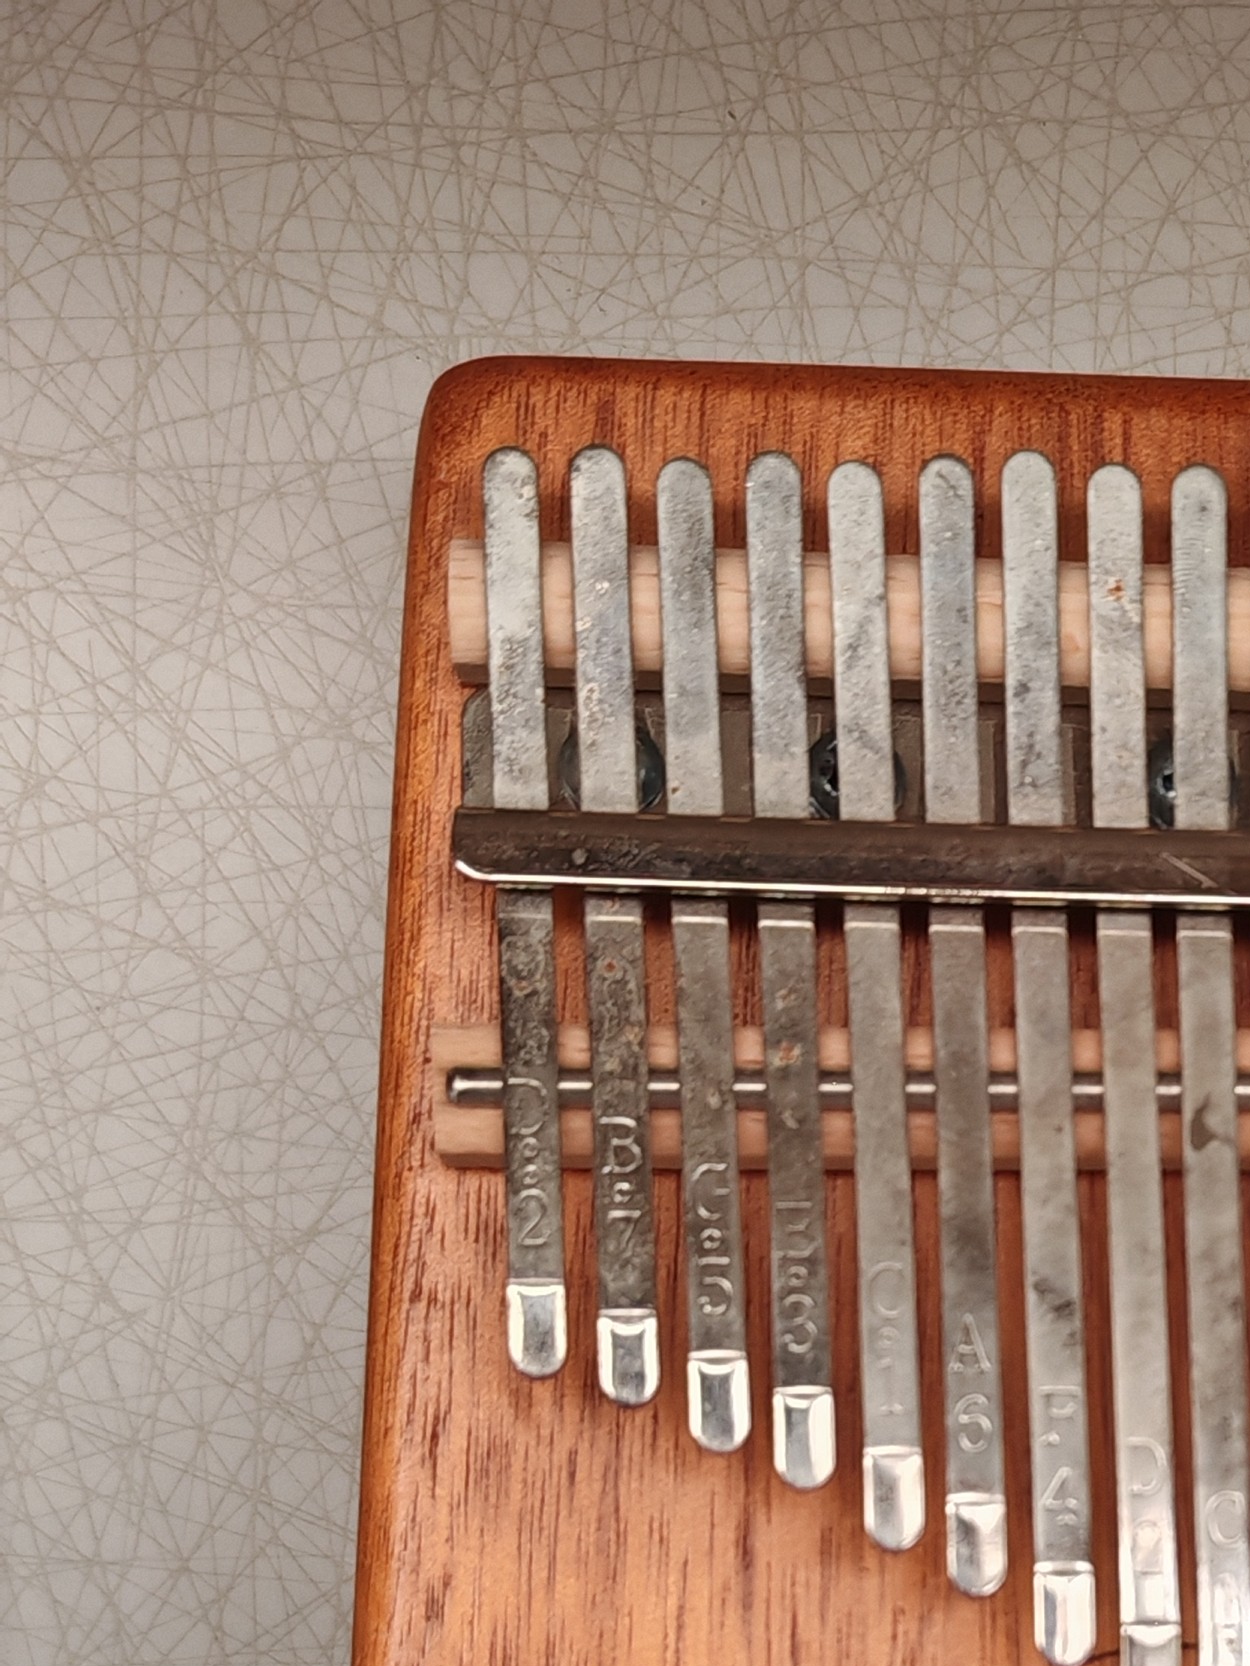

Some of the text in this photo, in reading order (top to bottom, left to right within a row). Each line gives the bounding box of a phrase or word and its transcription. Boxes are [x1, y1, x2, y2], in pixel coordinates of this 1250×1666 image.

[516, 1187, 551, 1246] 2
[949, 1312, 992, 1374] A
[1205, 1490, 1246, 1548] C
